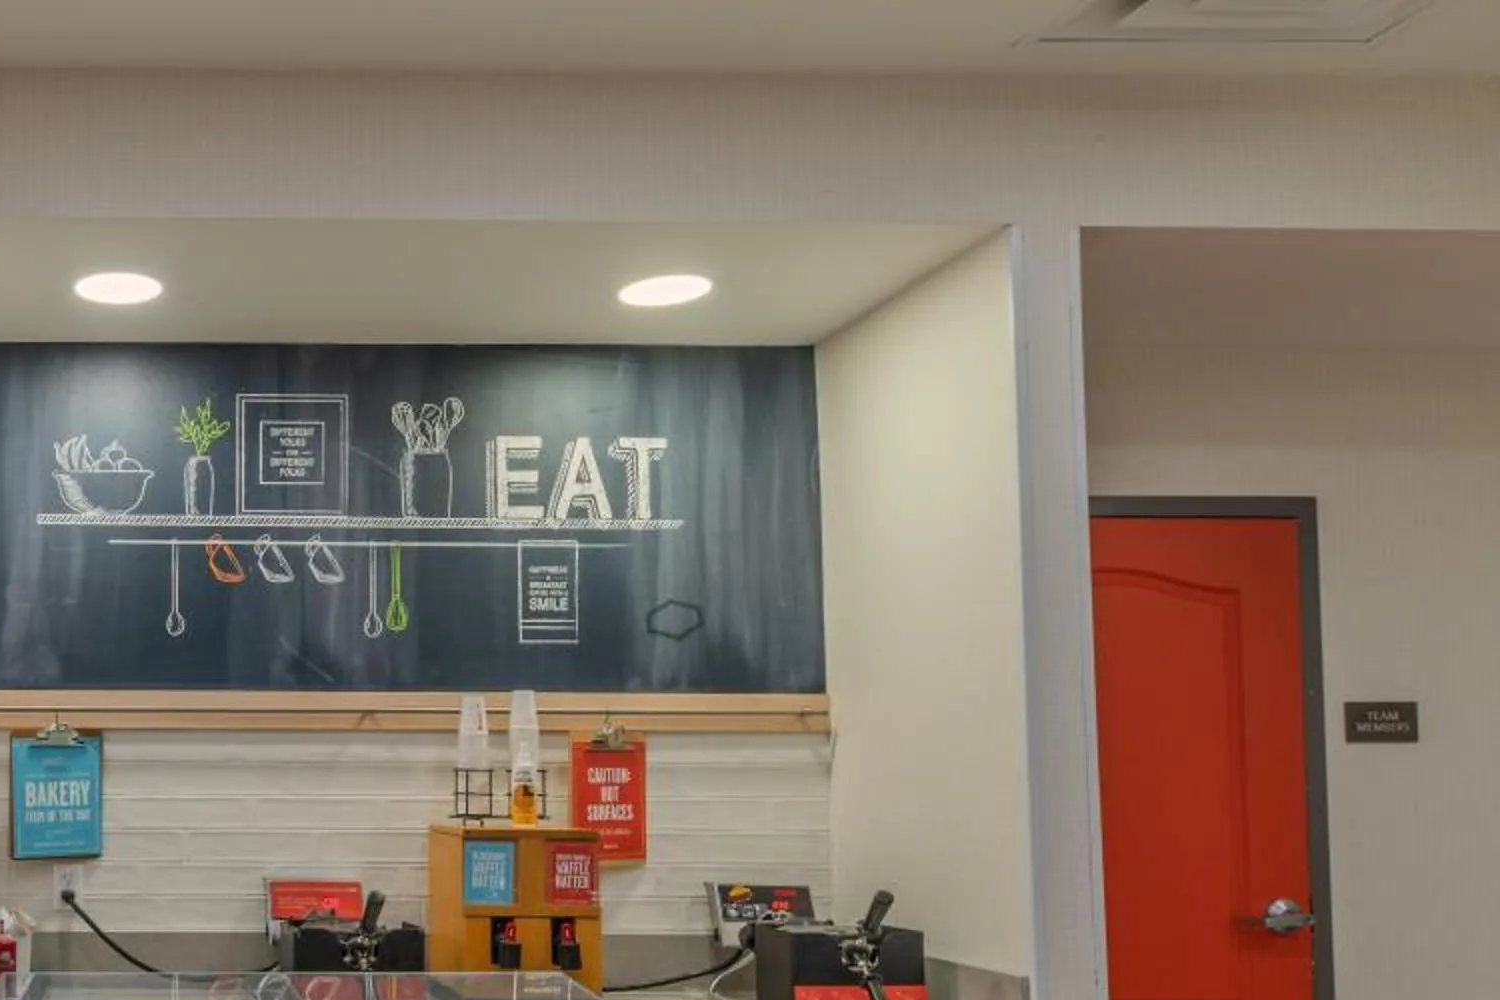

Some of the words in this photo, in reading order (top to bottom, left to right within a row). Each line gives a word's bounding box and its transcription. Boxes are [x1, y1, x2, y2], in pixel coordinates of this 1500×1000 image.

[486, 435, 668, 520] EAT
[529, 597, 569, 611] SMILE
[1367, 711, 1400, 721] TEAM
[25, 781, 91, 807] BAKERY
[555, 861, 590, 874] WAFFLE
